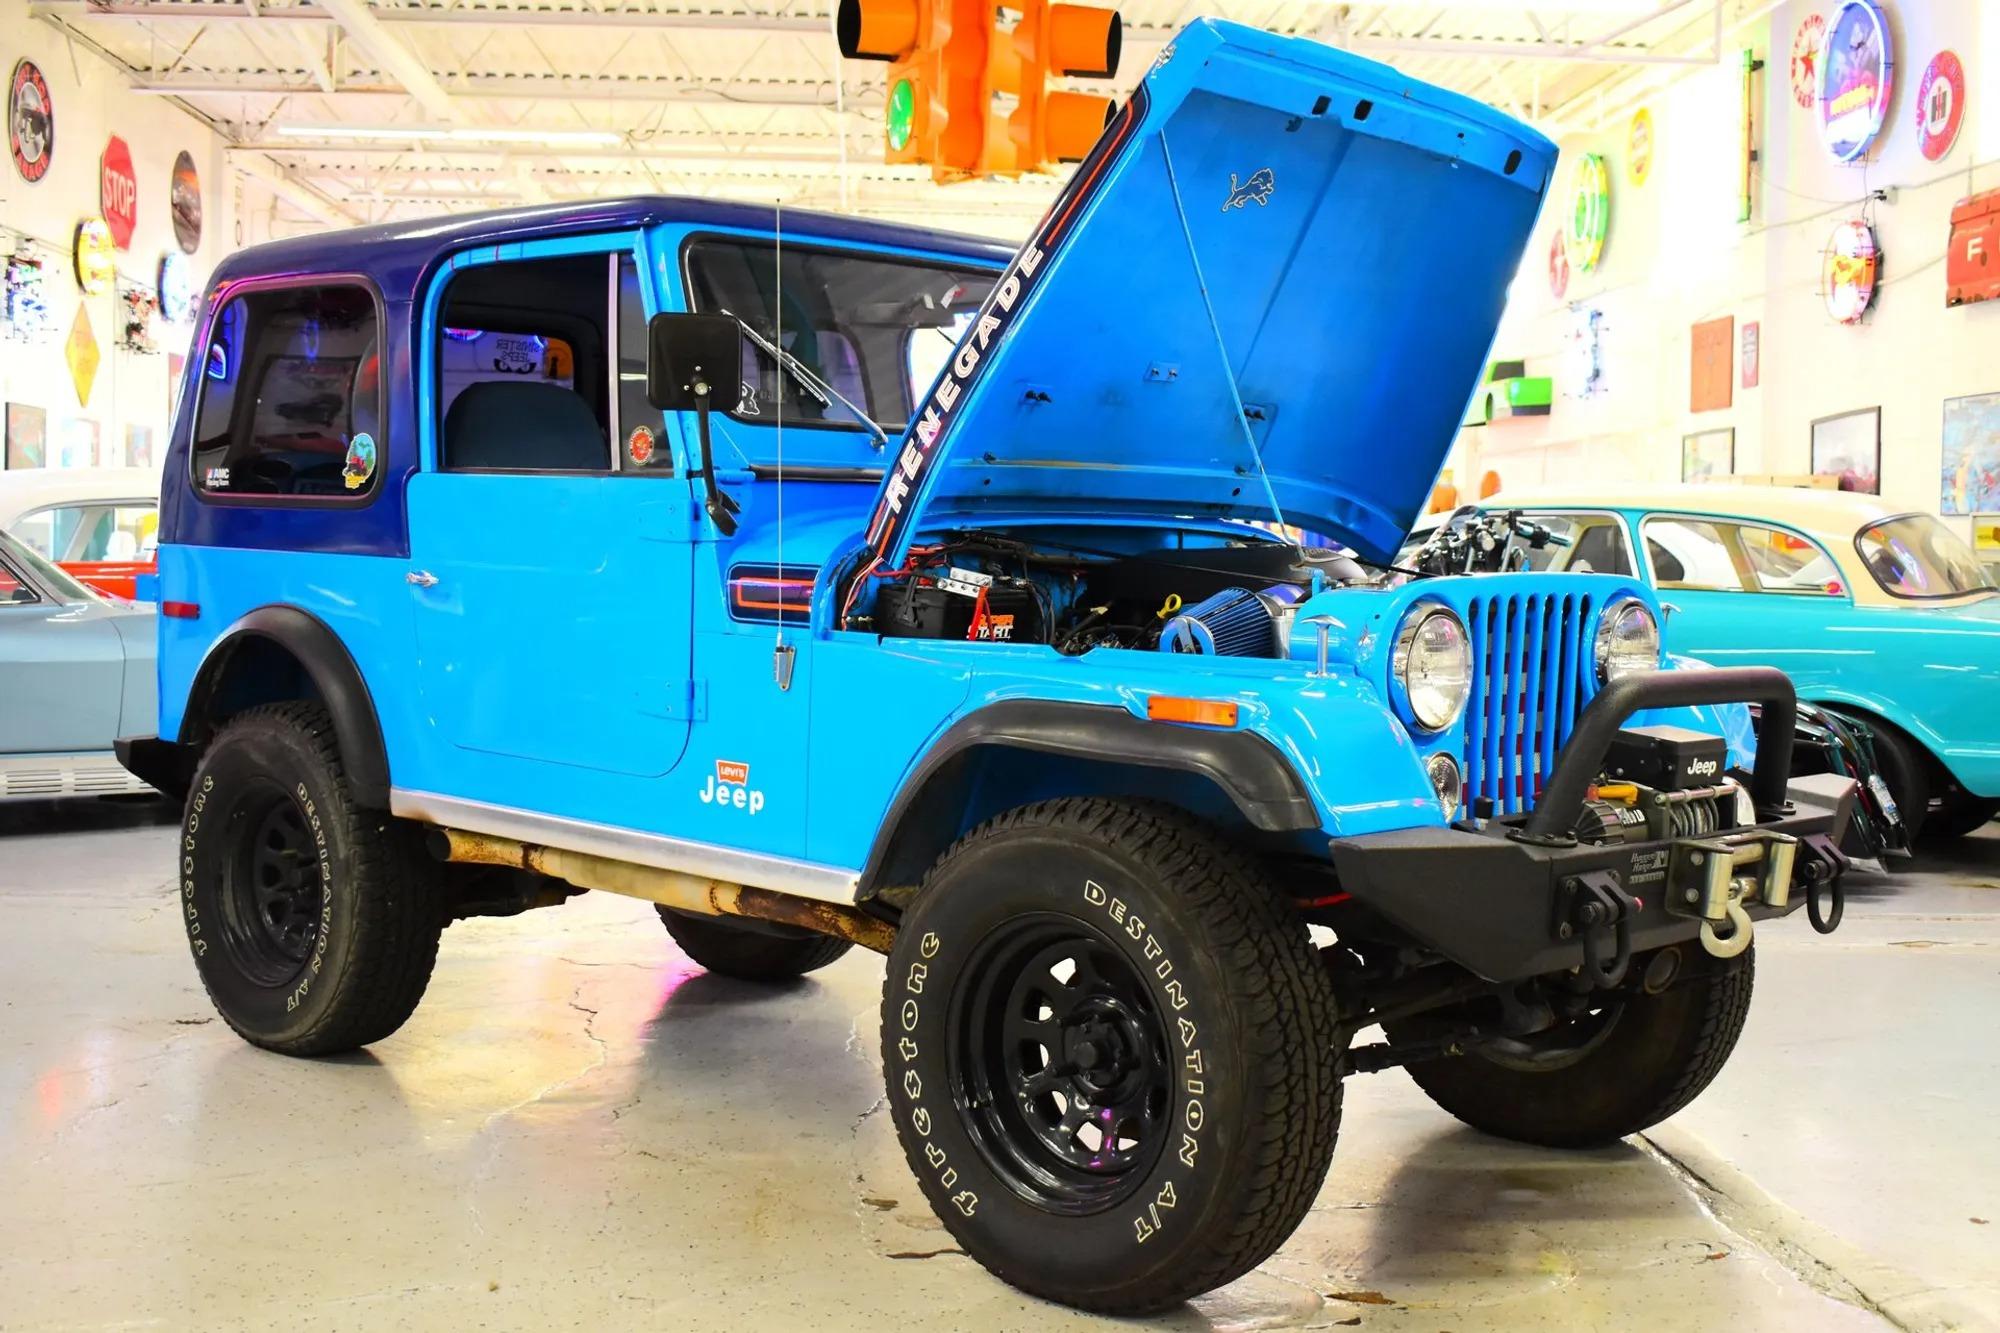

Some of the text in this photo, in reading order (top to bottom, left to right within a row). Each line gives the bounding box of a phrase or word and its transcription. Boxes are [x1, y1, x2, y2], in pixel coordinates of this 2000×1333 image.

[104, 166, 135, 220] STOP
[885, 240, 1044, 515] RENEGADE
[699, 775, 765, 816] Jeep
[1687, 757, 1717, 777] Jeep
[287, 782, 332, 1013] DESTINATION A/T
[1084, 880, 1204, 1243] DESTINATION A/T
